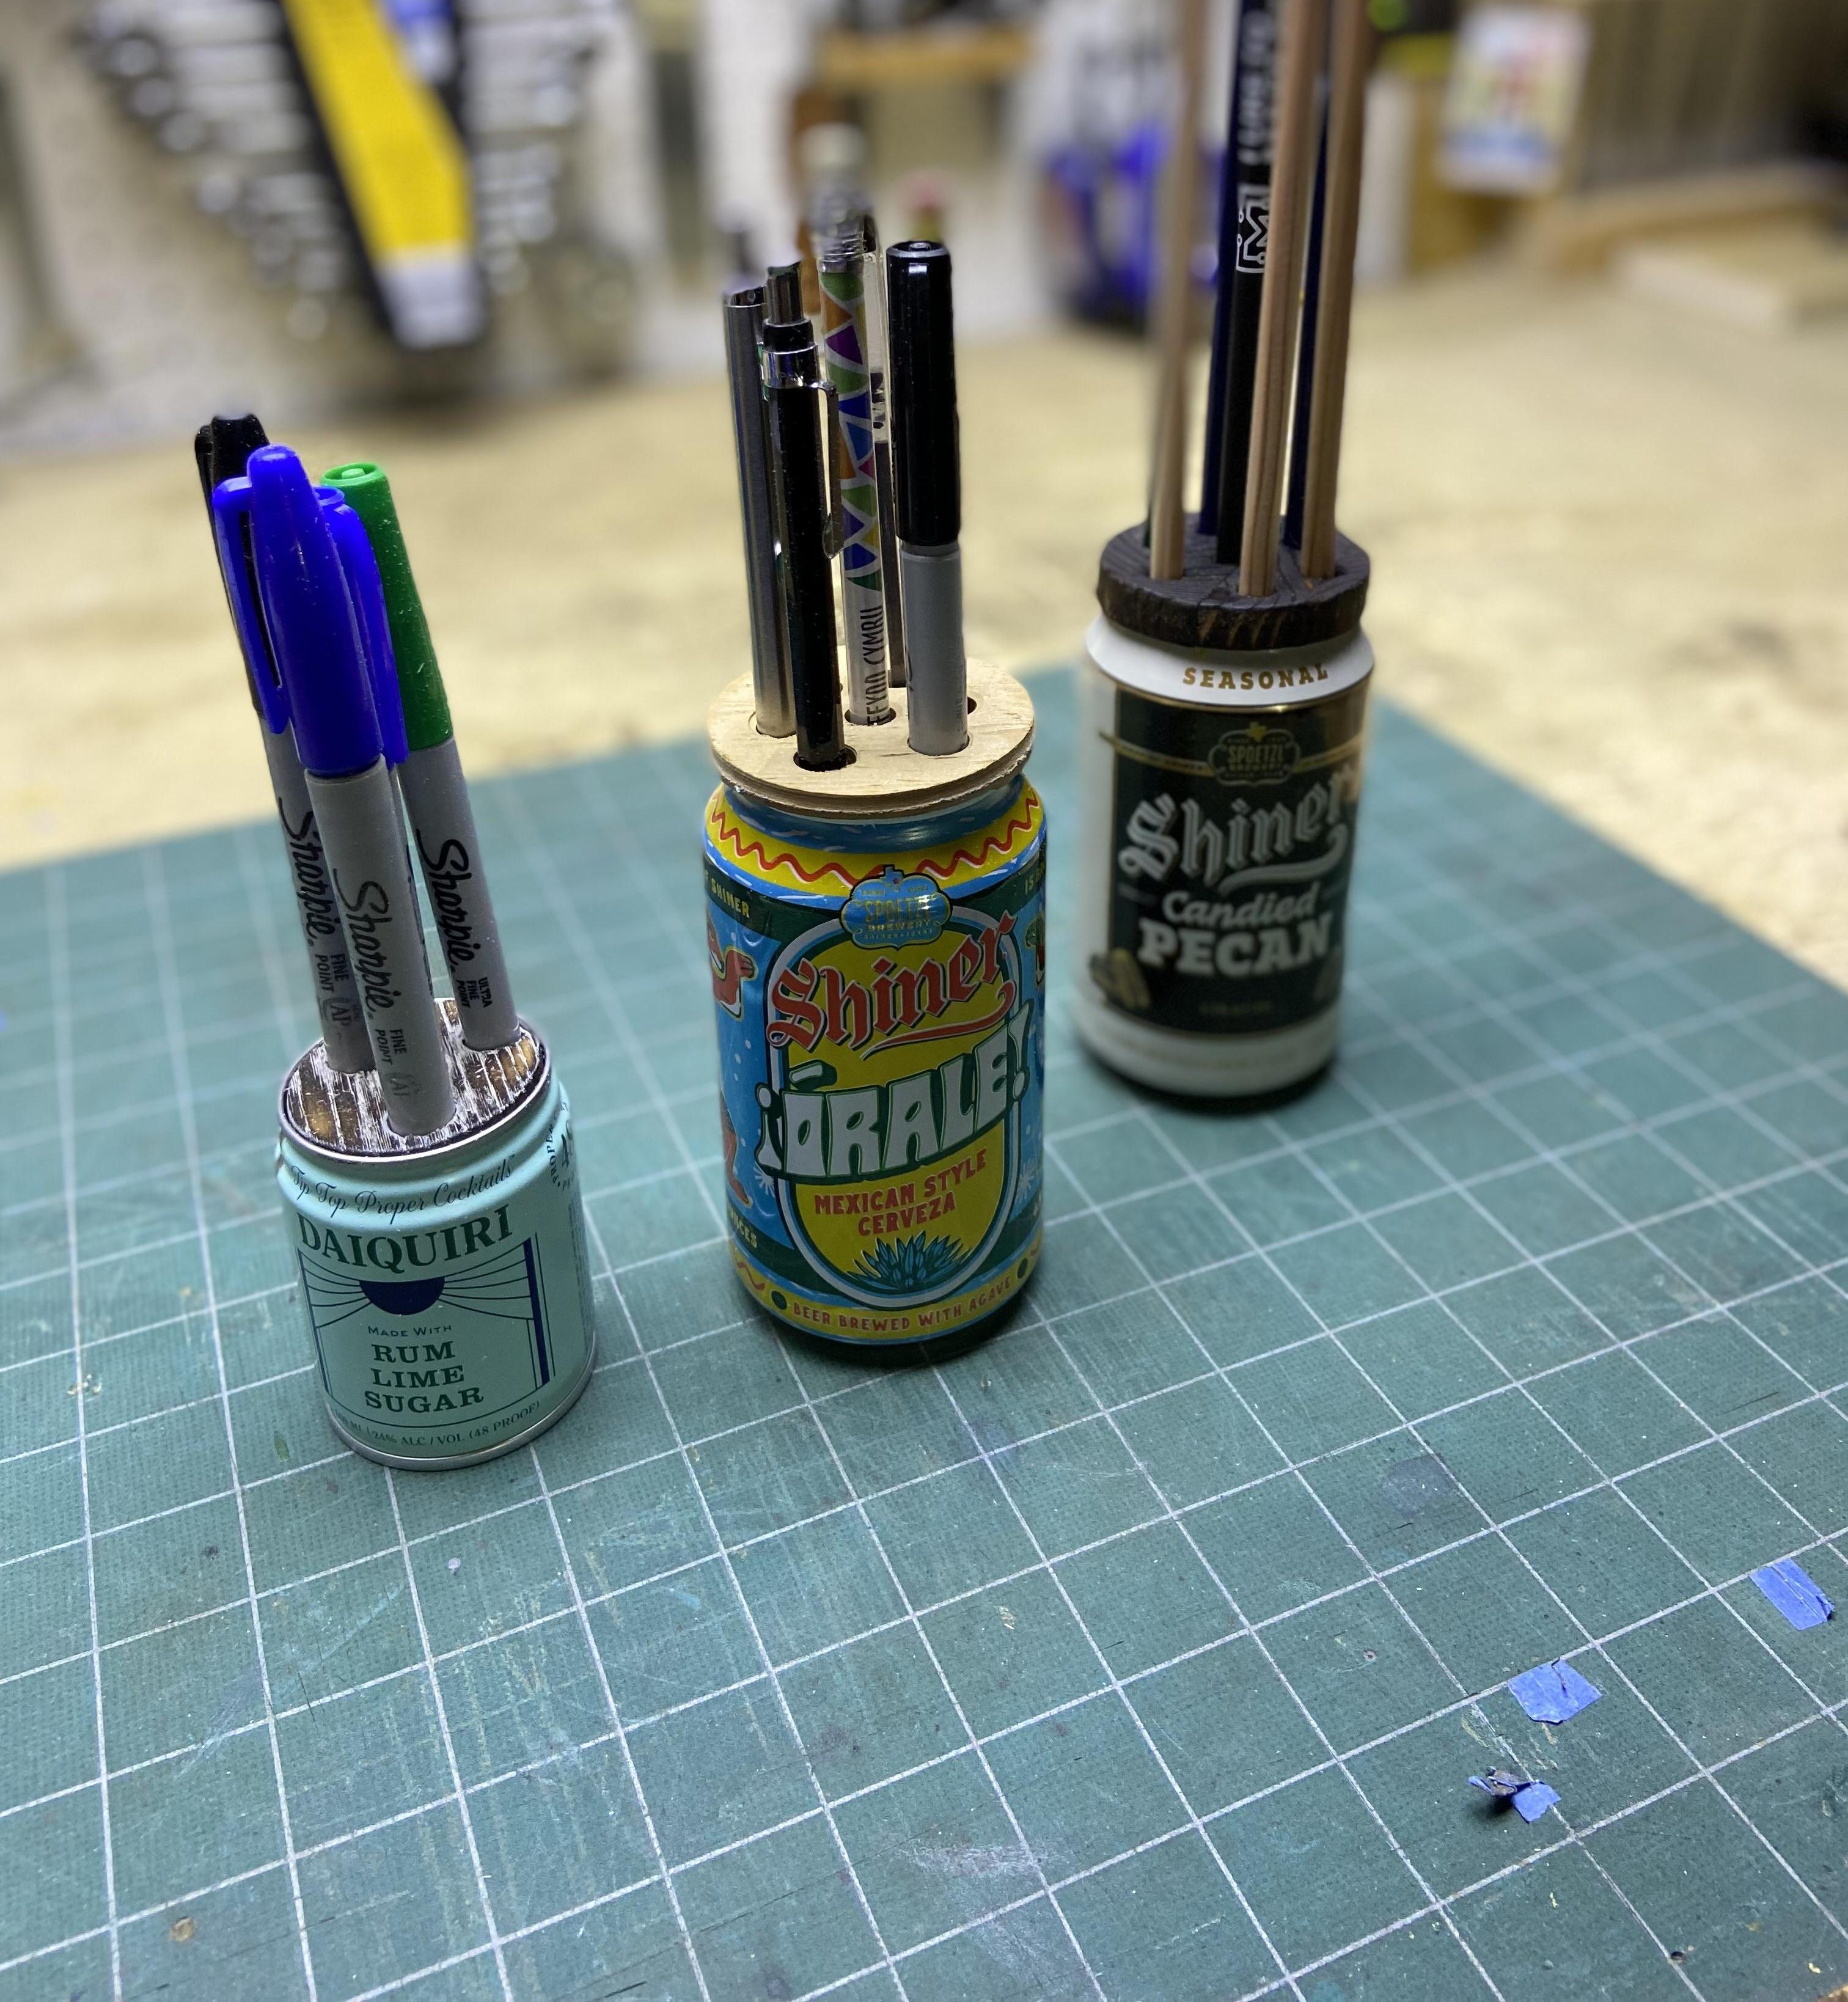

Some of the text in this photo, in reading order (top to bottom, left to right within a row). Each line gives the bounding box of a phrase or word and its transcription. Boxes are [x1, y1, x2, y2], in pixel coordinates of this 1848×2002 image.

[1182, 664, 1329, 691] SEASONAL
[1118, 764, 1357, 889] Shiner
[711, 878, 750, 918] SHINER
[1162, 881, 1320, 929] Candied
[1137, 912, 1333, 977] PECAN
[315, 953, 334, 992] POINT
[331, 953, 349, 981] FINE
[766, 910, 1018, 1054] Shiner
[457, 980, 471, 1008] POINT
[466, 979, 479, 1001] FINE
[479, 976, 493, 1008] ULTRA
[375, 1029, 393, 1065] POINT
[390, 1028, 408, 1055] FINE
[291, 1165, 310, 1200] Tip
[316, 1182, 348, 1218] Top
[354, 1190, 427, 1225] Proper
[815, 1147, 987, 1215] MEXICAN STYLE
[858, 1192, 956, 1236] CERVEZA
[298, 1203, 513, 1274] DAIQUIRI
[793, 1275, 1012, 1331] BEER BREWED WITH AGAVE
[371, 1341, 456, 1363] RUM
[370, 1365, 464, 1388] LIME
[364, 1387, 484, 1414] SUGAR
[493, 1400, 540, 1432] PROOF)
